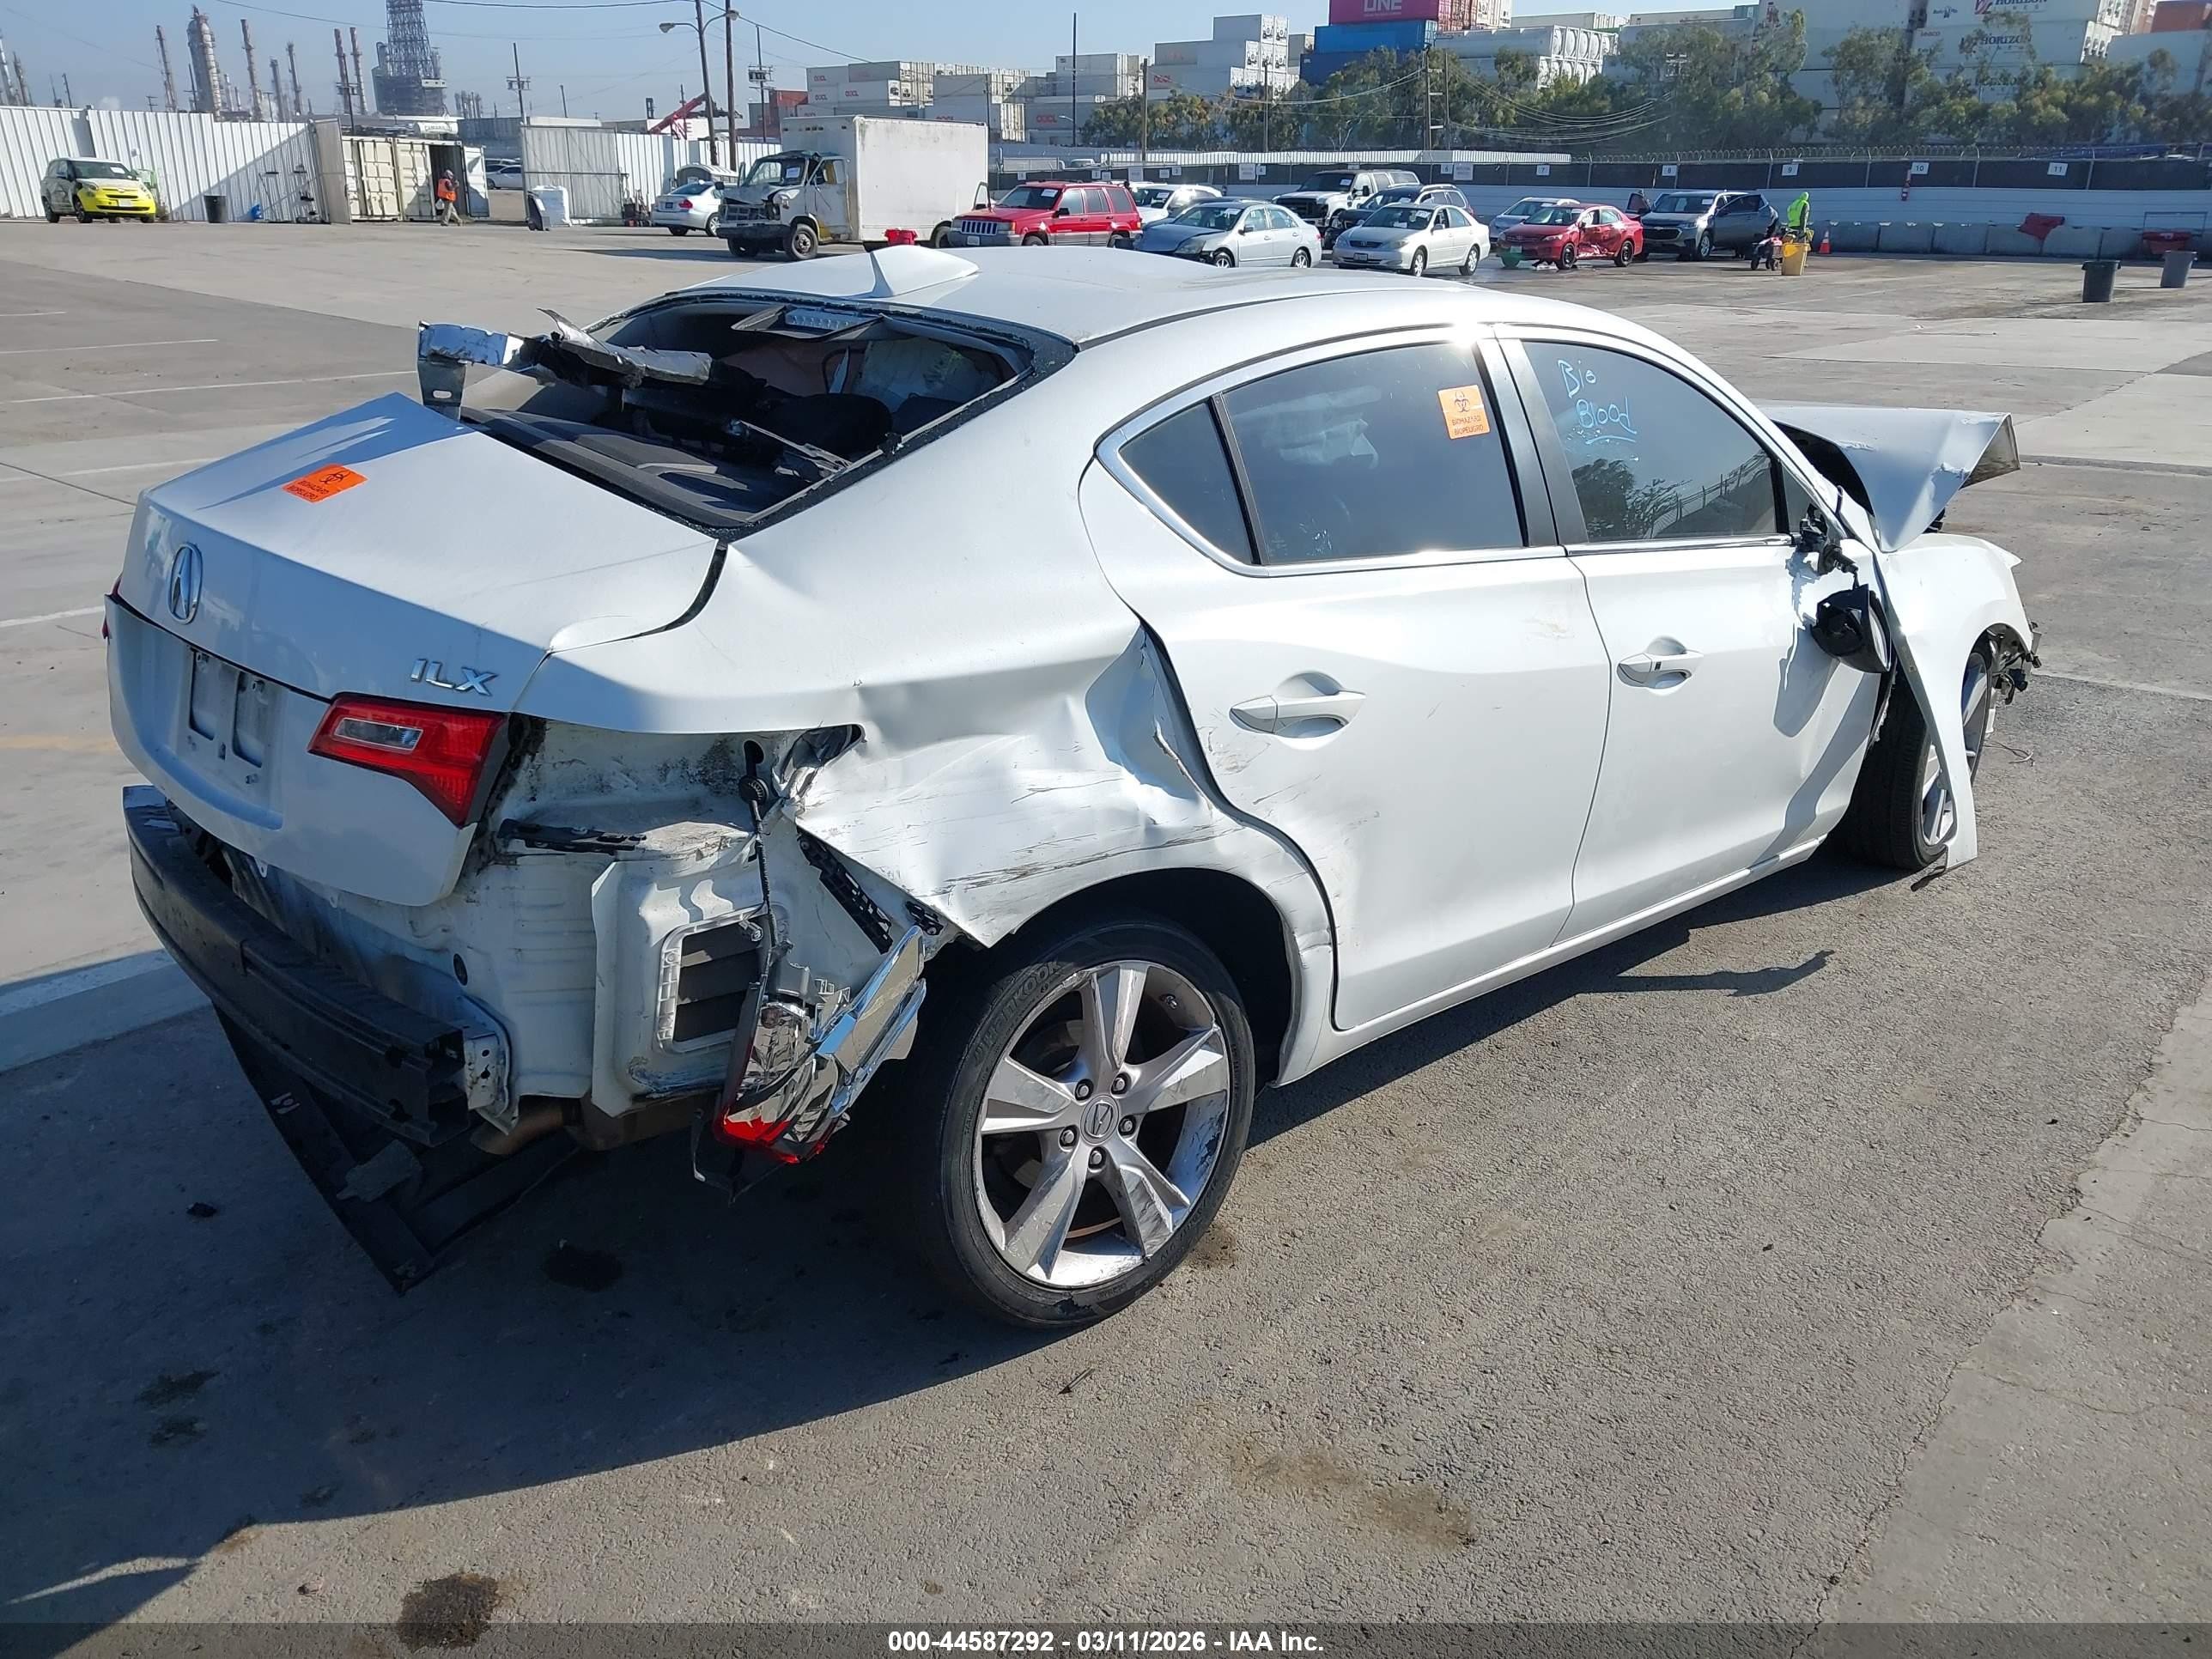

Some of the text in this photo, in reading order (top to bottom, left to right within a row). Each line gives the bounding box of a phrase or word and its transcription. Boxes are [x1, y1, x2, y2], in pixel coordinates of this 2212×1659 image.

[1558, 359, 1596, 398] Bio
[1576, 392, 1638, 434] Blood
[410, 658, 499, 696] ILX
